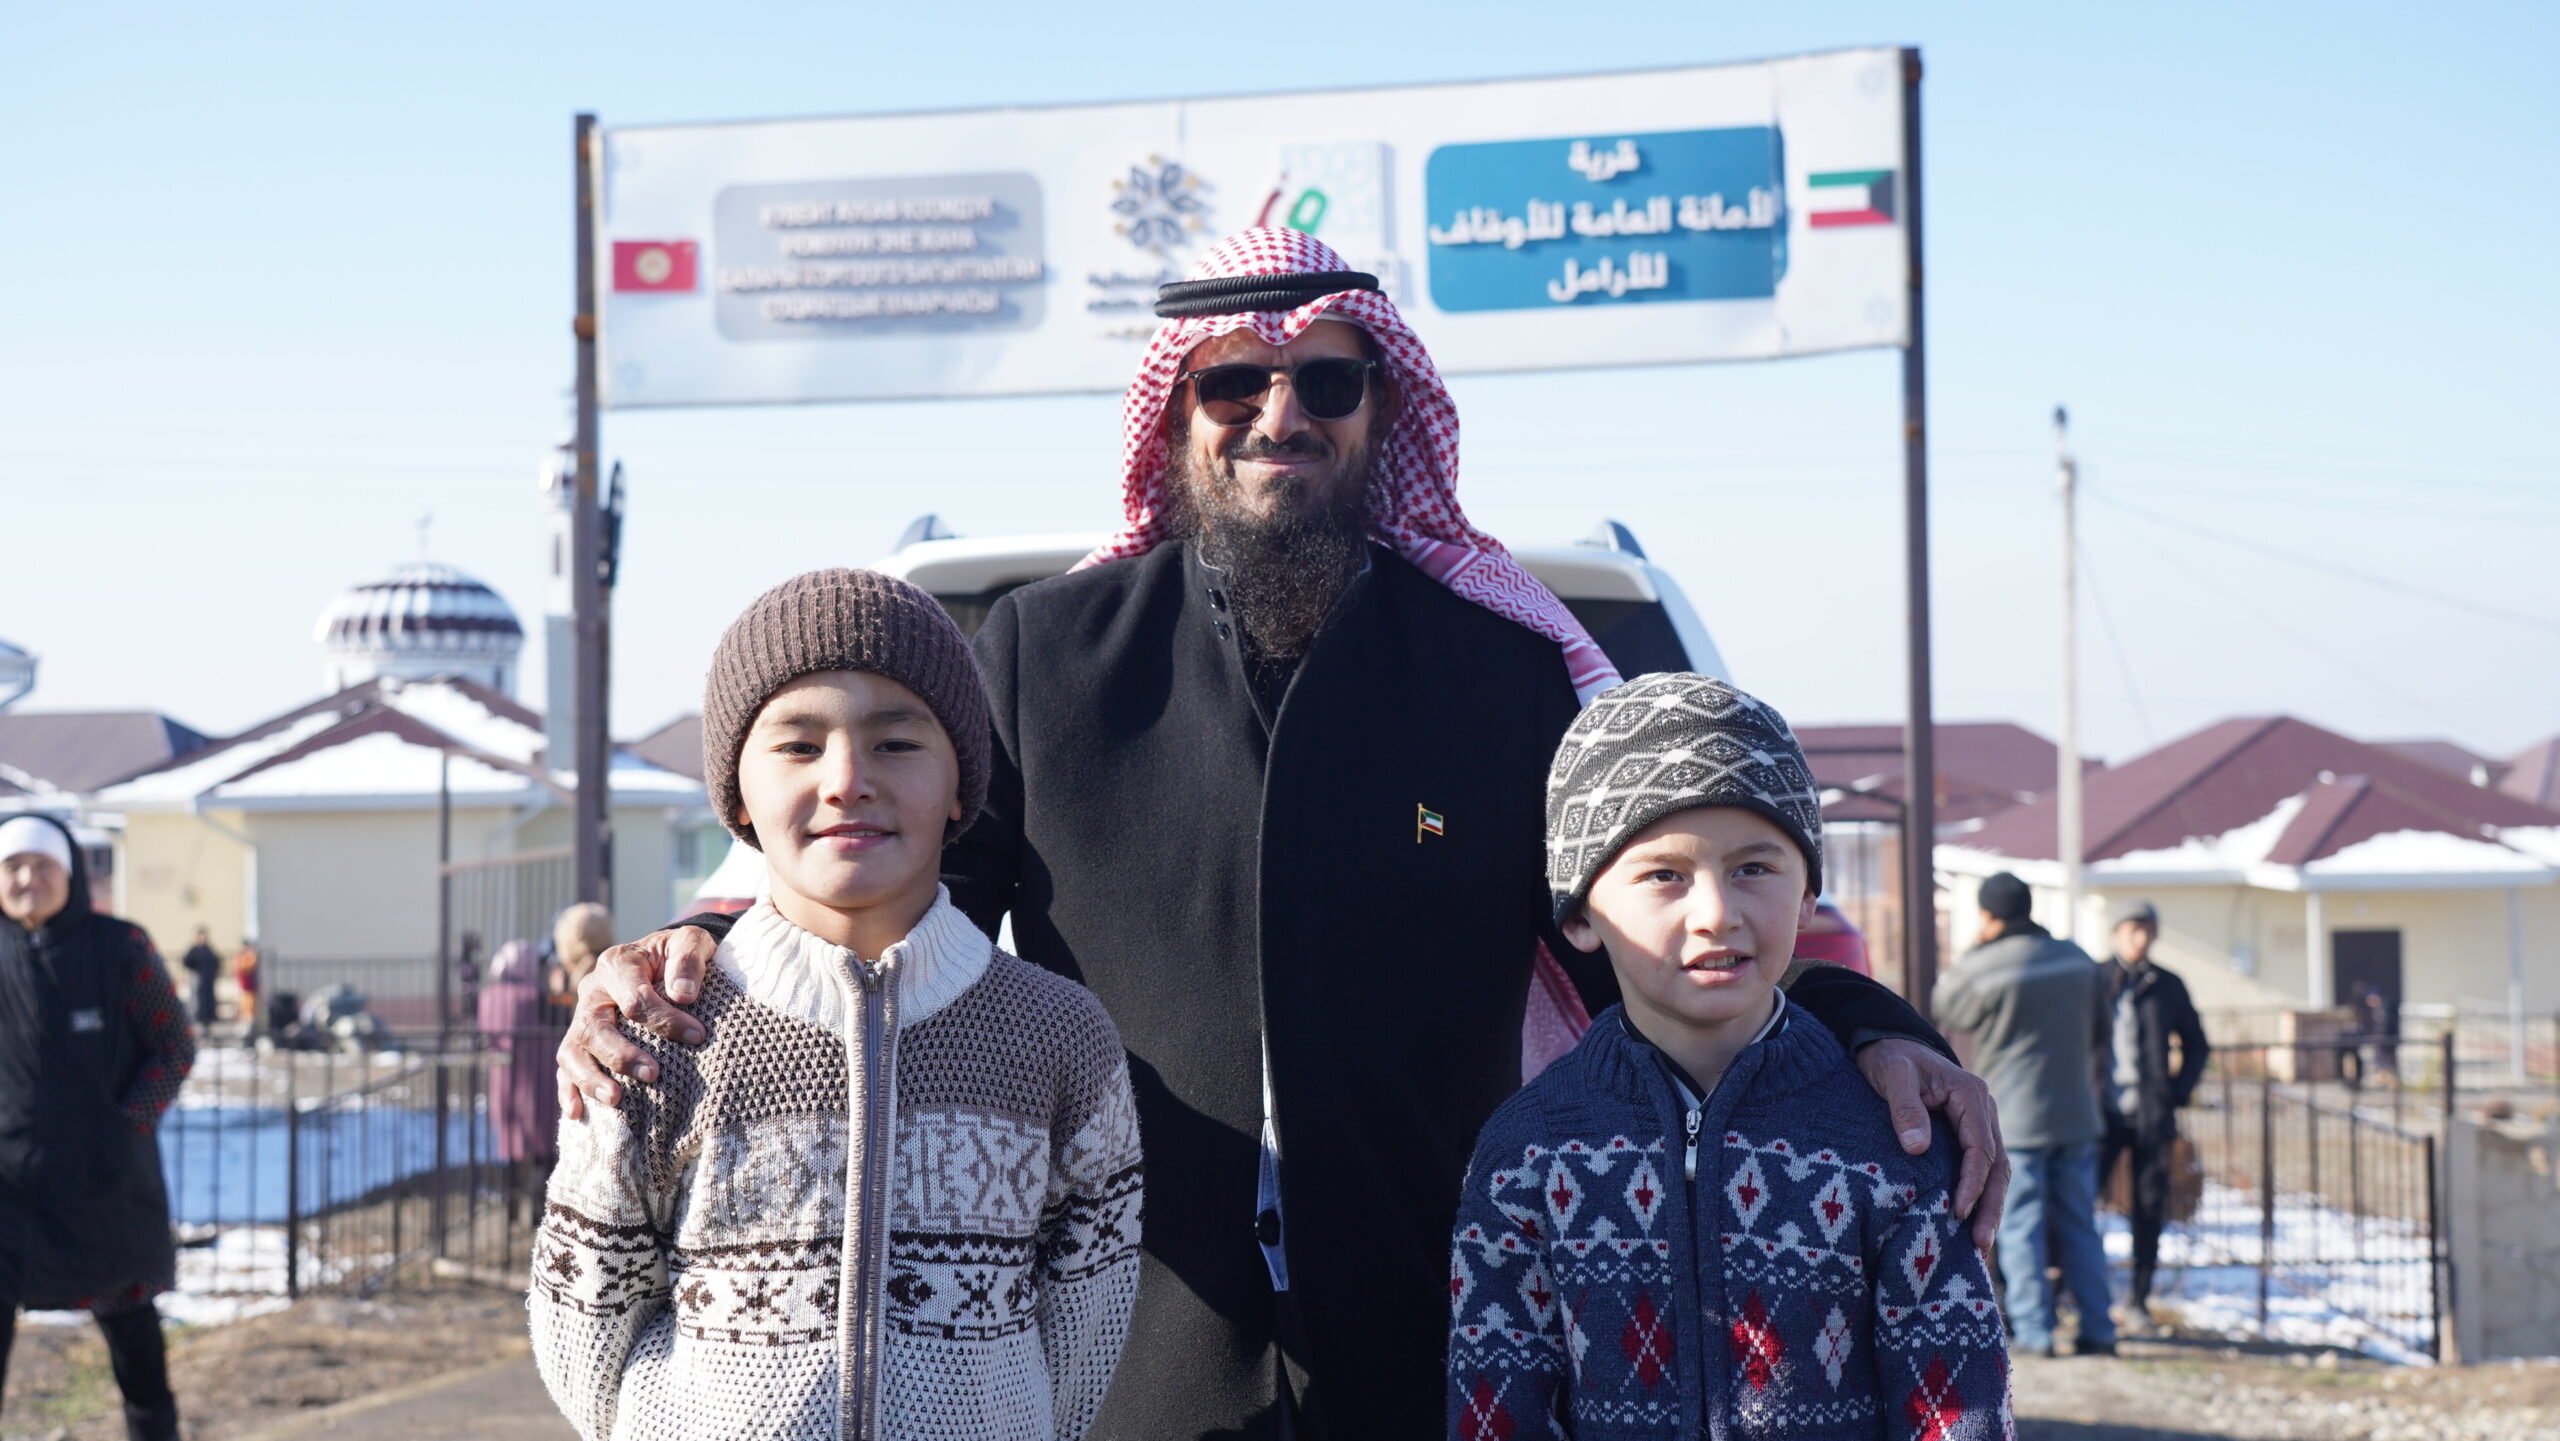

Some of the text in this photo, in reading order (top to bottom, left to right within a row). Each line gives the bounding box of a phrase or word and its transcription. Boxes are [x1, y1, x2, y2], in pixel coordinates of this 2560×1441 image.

[1569, 140, 1639, 182] قرية
[1431, 198, 1565, 248] للأوقاف
[1572, 198, 1672, 236] العامة
[1549, 252, 1668, 301] للأرامل
